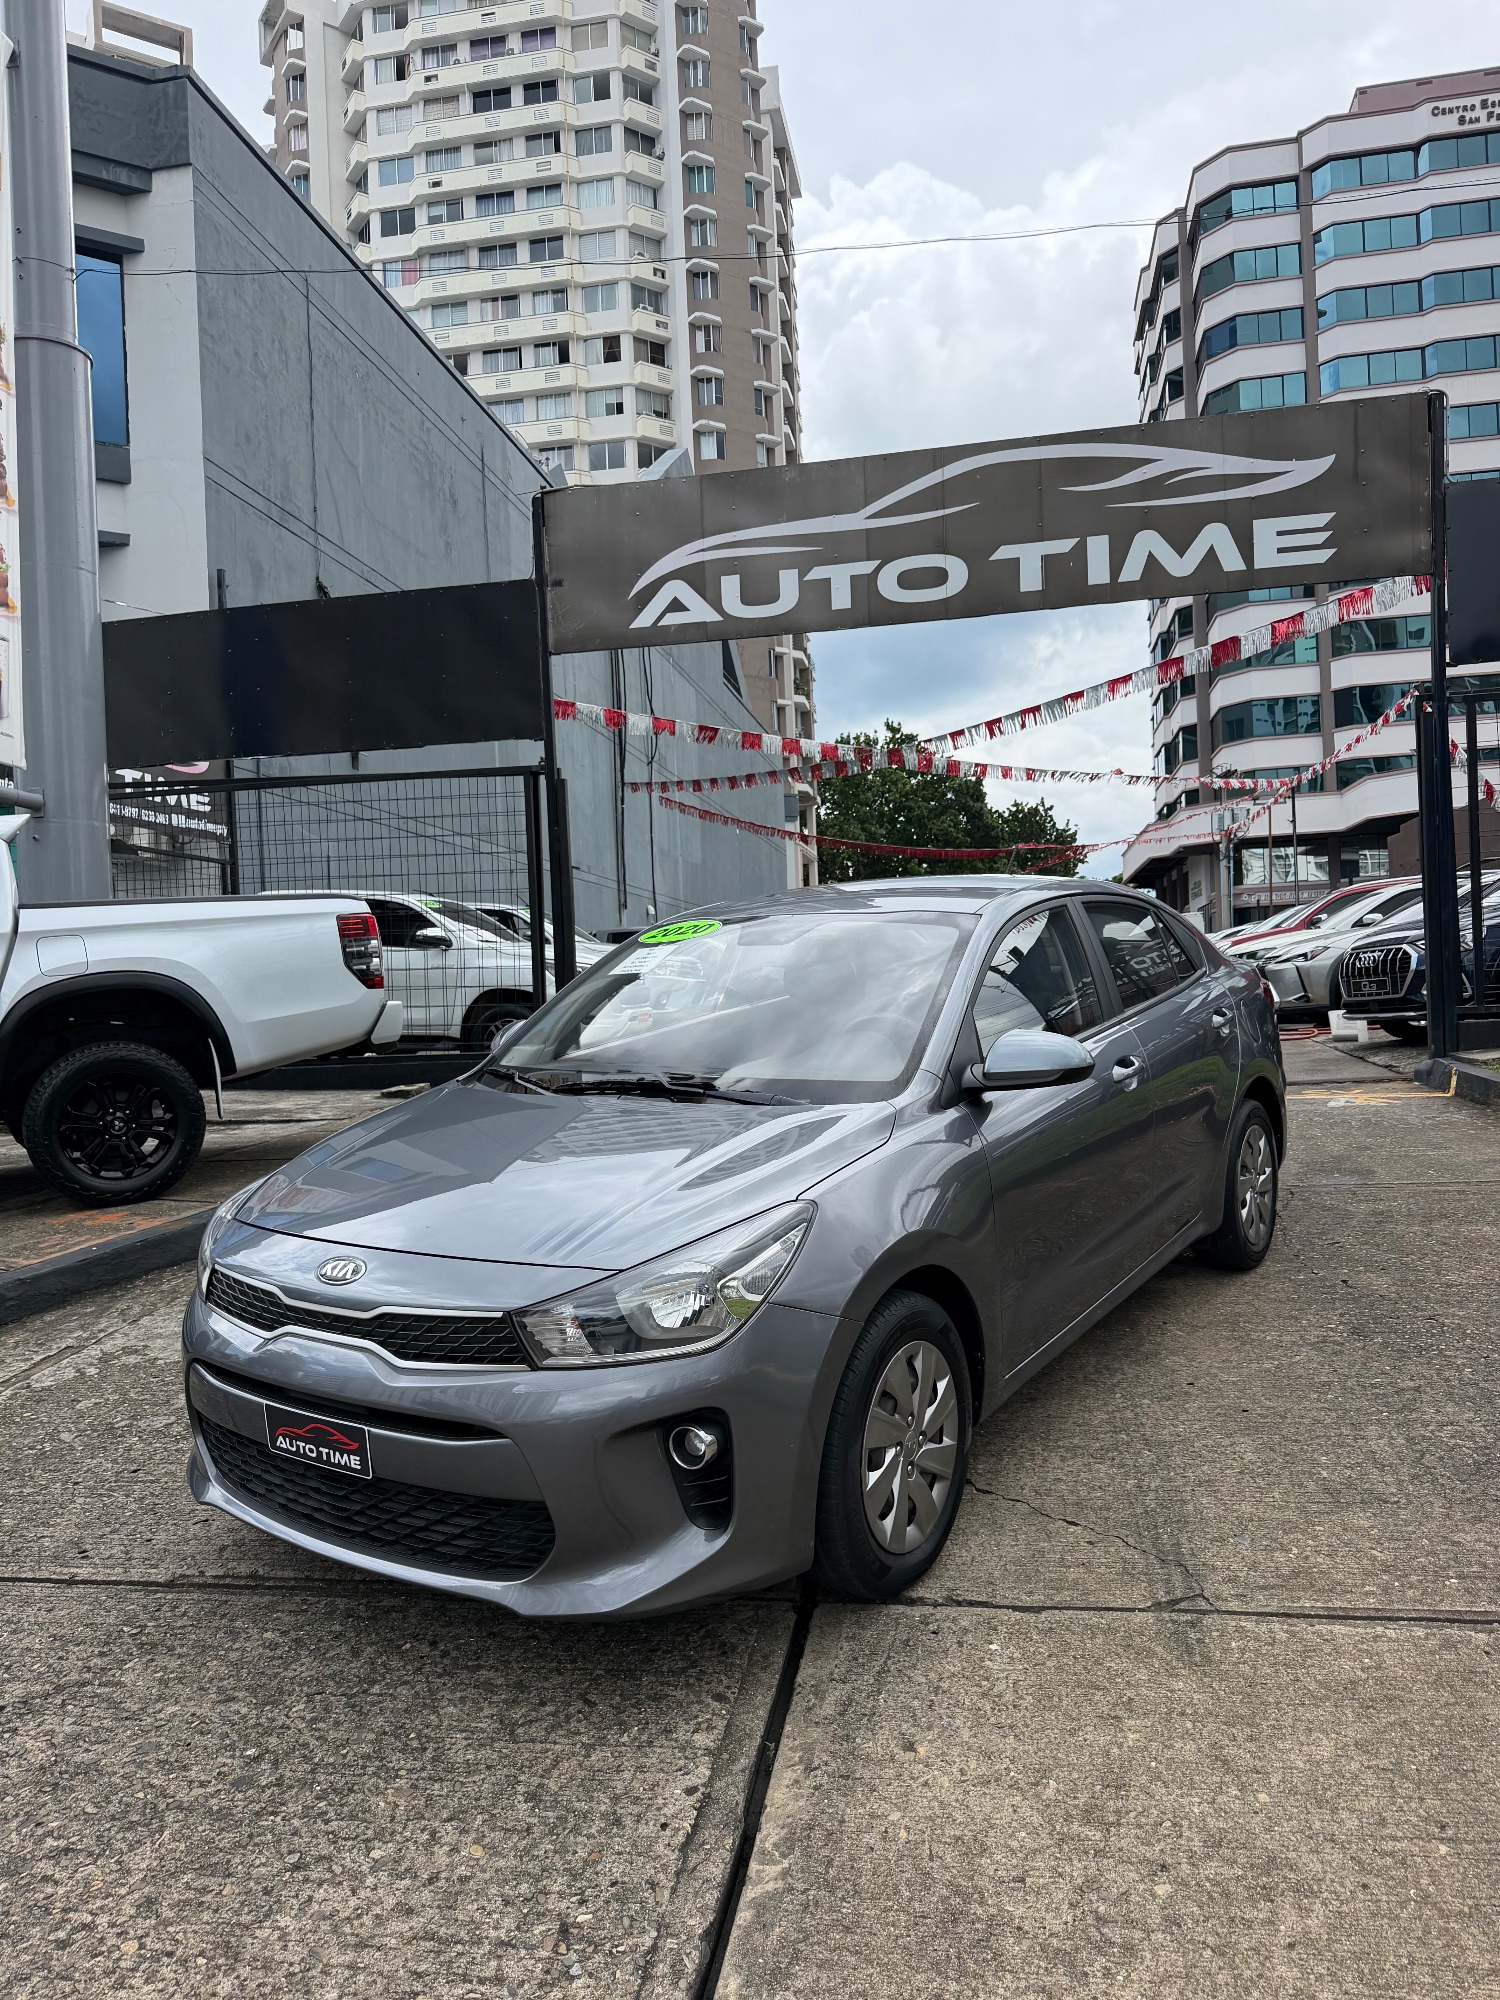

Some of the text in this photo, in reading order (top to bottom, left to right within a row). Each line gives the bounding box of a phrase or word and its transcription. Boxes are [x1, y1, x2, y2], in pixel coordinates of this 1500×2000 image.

[628, 511, 1338, 629] AUTO TIME
[320, 1260, 357, 1279] KIA
[276, 1435, 362, 1470] AUTO TIME
